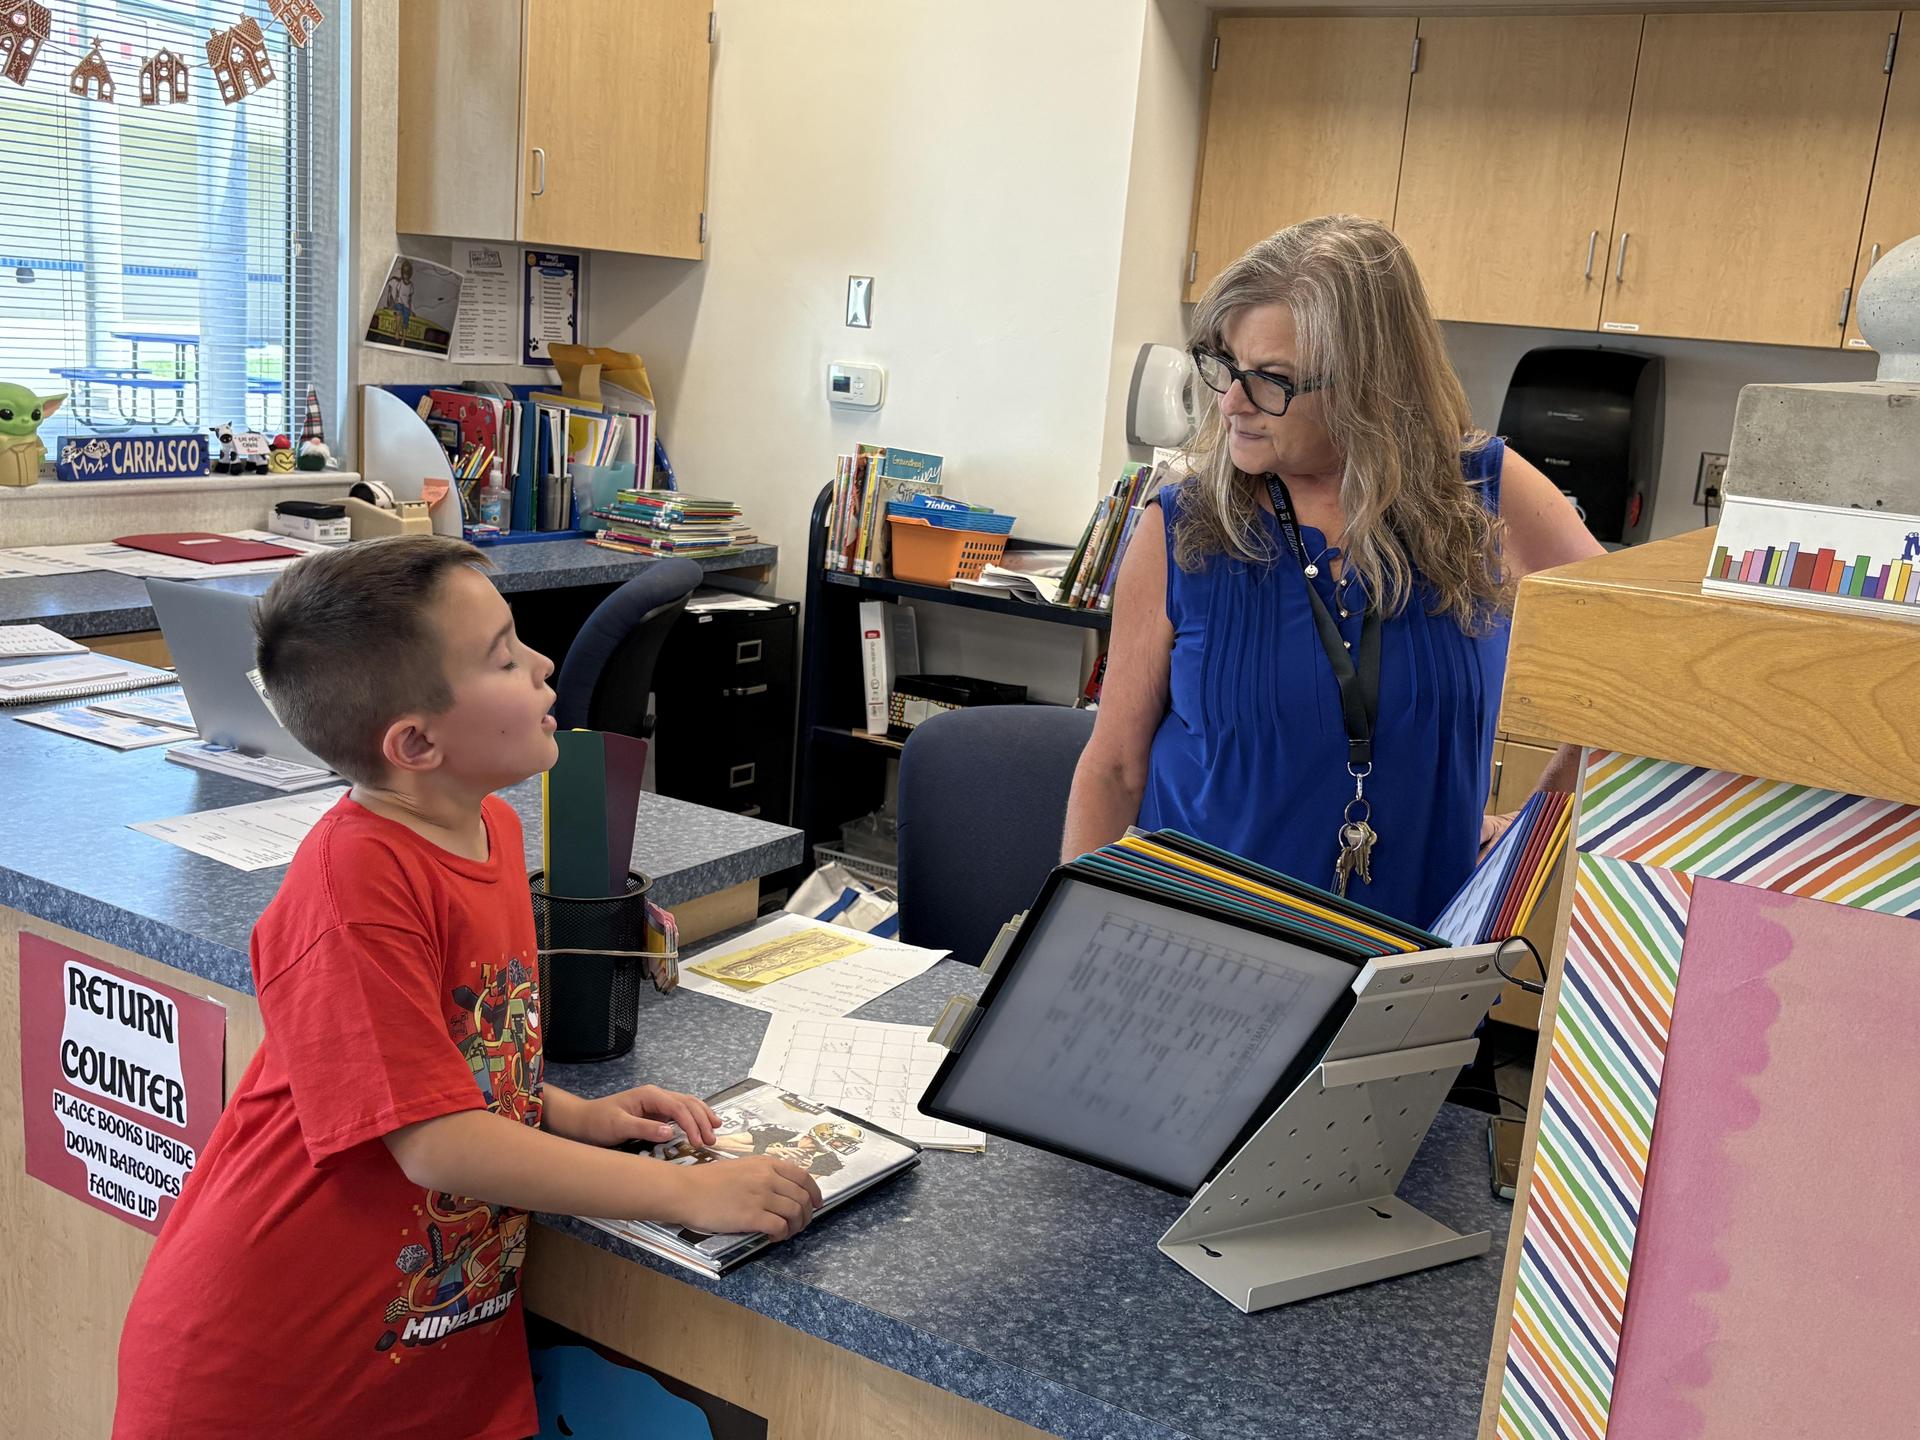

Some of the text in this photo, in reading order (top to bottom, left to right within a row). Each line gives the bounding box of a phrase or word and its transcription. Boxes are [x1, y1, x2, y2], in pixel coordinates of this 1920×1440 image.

[71, 439, 199, 480] Mrs. CARRASCO
[68, 966, 175, 1044] RETURN
[61, 1039, 186, 1124] COUNTER
[53, 1092, 194, 1170] PLACE BOOKS UPSIDE
[66, 1129, 181, 1197] DOWN BARCODES
[89, 1173, 158, 1218] FACING UP
[401, 1288, 518, 1341] MINECRAF
